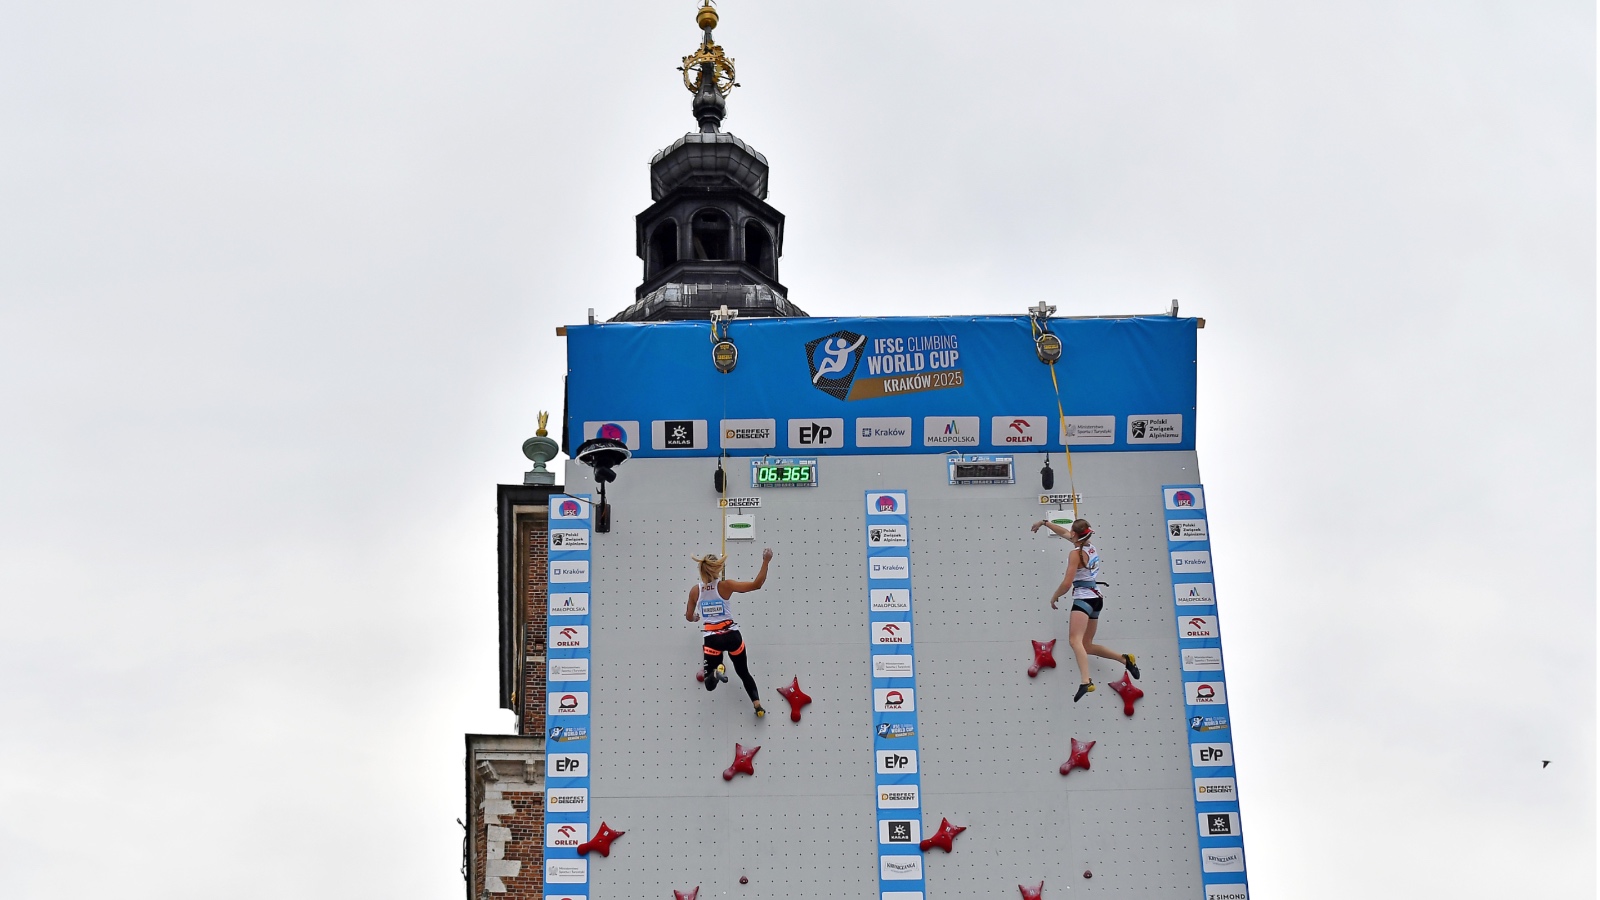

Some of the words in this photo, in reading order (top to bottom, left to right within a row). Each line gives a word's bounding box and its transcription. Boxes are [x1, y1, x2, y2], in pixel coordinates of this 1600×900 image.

[874, 338, 904, 354] IFSC
[907, 335, 958, 352] CLIMBING
[867, 352, 925, 375] WORLD
[929, 350, 959, 369] CUP
[883, 373, 931, 393] KRAKÓW
[932, 371, 962, 387] 2025
[874, 428, 905, 436] Kraków
[759, 467, 810, 482] 06.365
